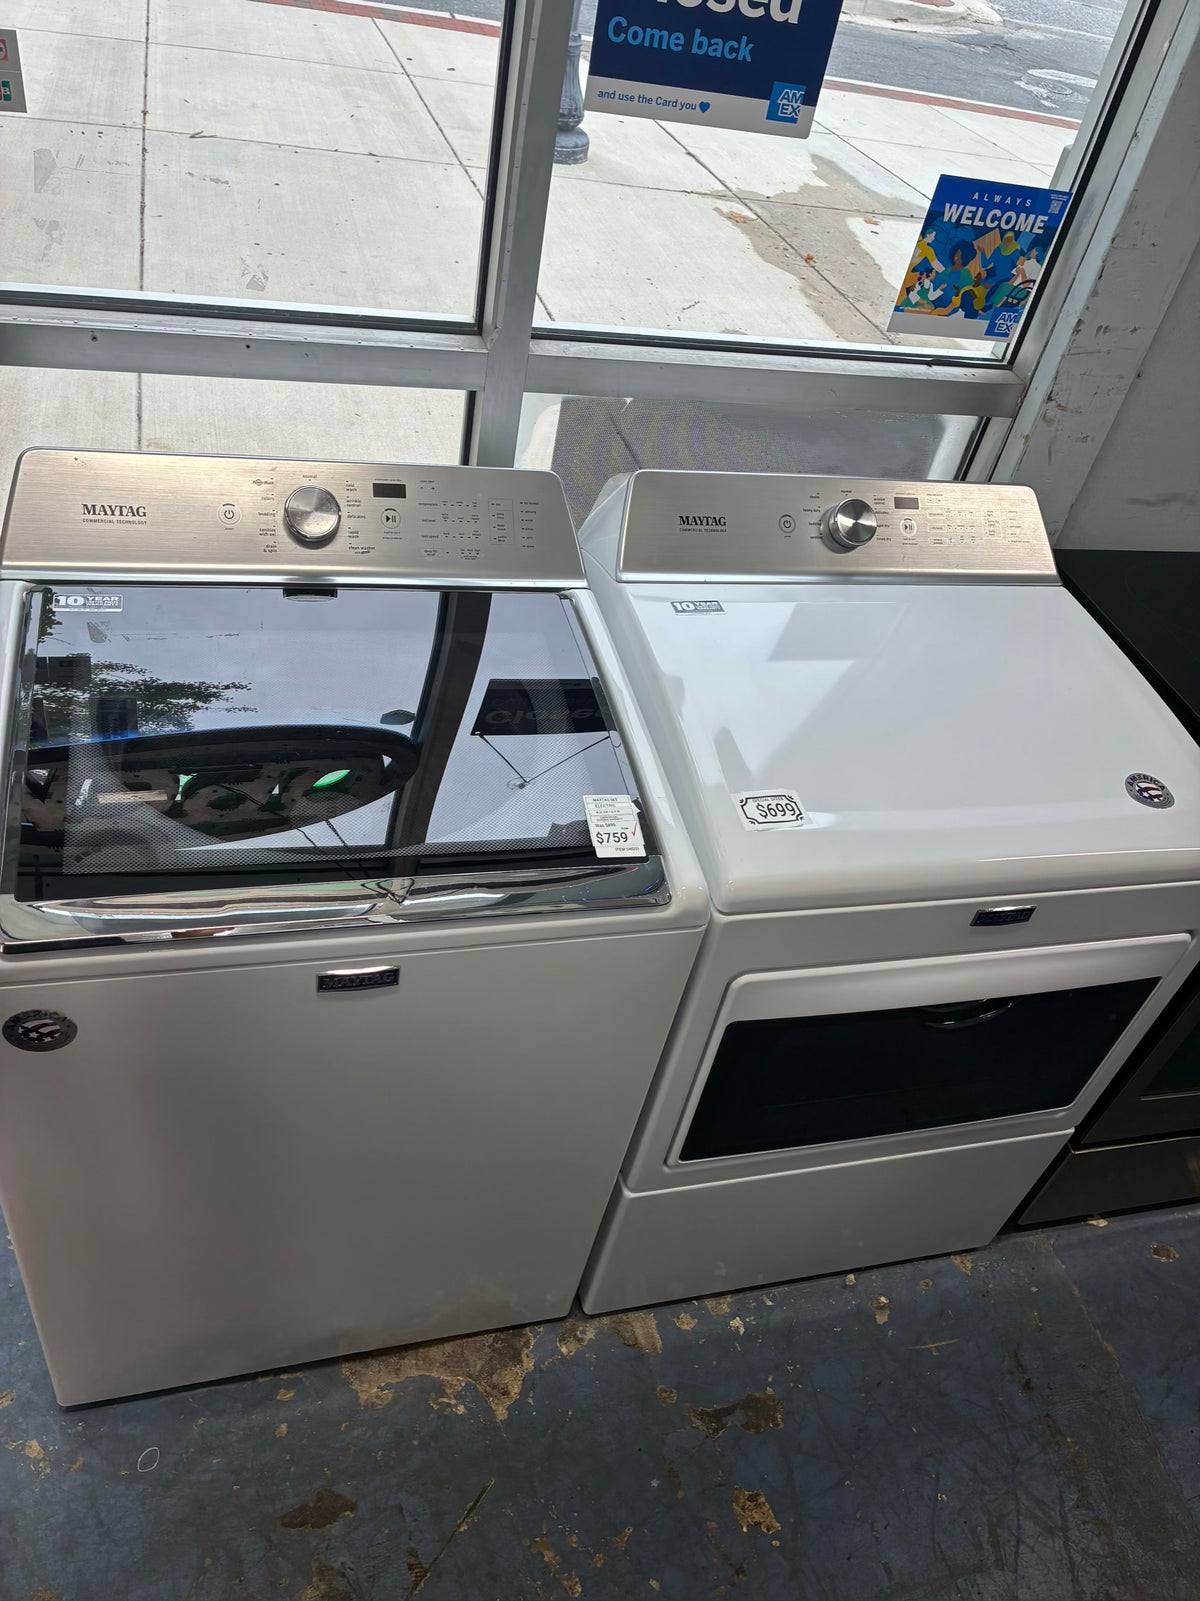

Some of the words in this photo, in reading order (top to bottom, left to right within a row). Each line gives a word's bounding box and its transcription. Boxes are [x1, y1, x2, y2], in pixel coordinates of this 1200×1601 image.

[608, 16, 684, 51] Come
[691, 29, 755, 62] back
[597, 90, 616, 99] and
[617, 93, 635, 102] use
[637, 94, 653, 104] the
[655, 96, 678, 107] Card
[679, 101, 697, 110] you
[778, 89, 804, 104] AM
[778, 103, 801, 118] EX
[972, 192, 1031, 207] ALWAYS
[943, 203, 1048, 234] WELCOME
[81, 503, 147, 517] MAYTAG
[678, 515, 727, 526] MAYTAG
[57, 596, 84, 606] 10
[673, 602, 695, 611] 10
[756, 803, 796, 819] $699
[596, 832, 628, 844] $759
